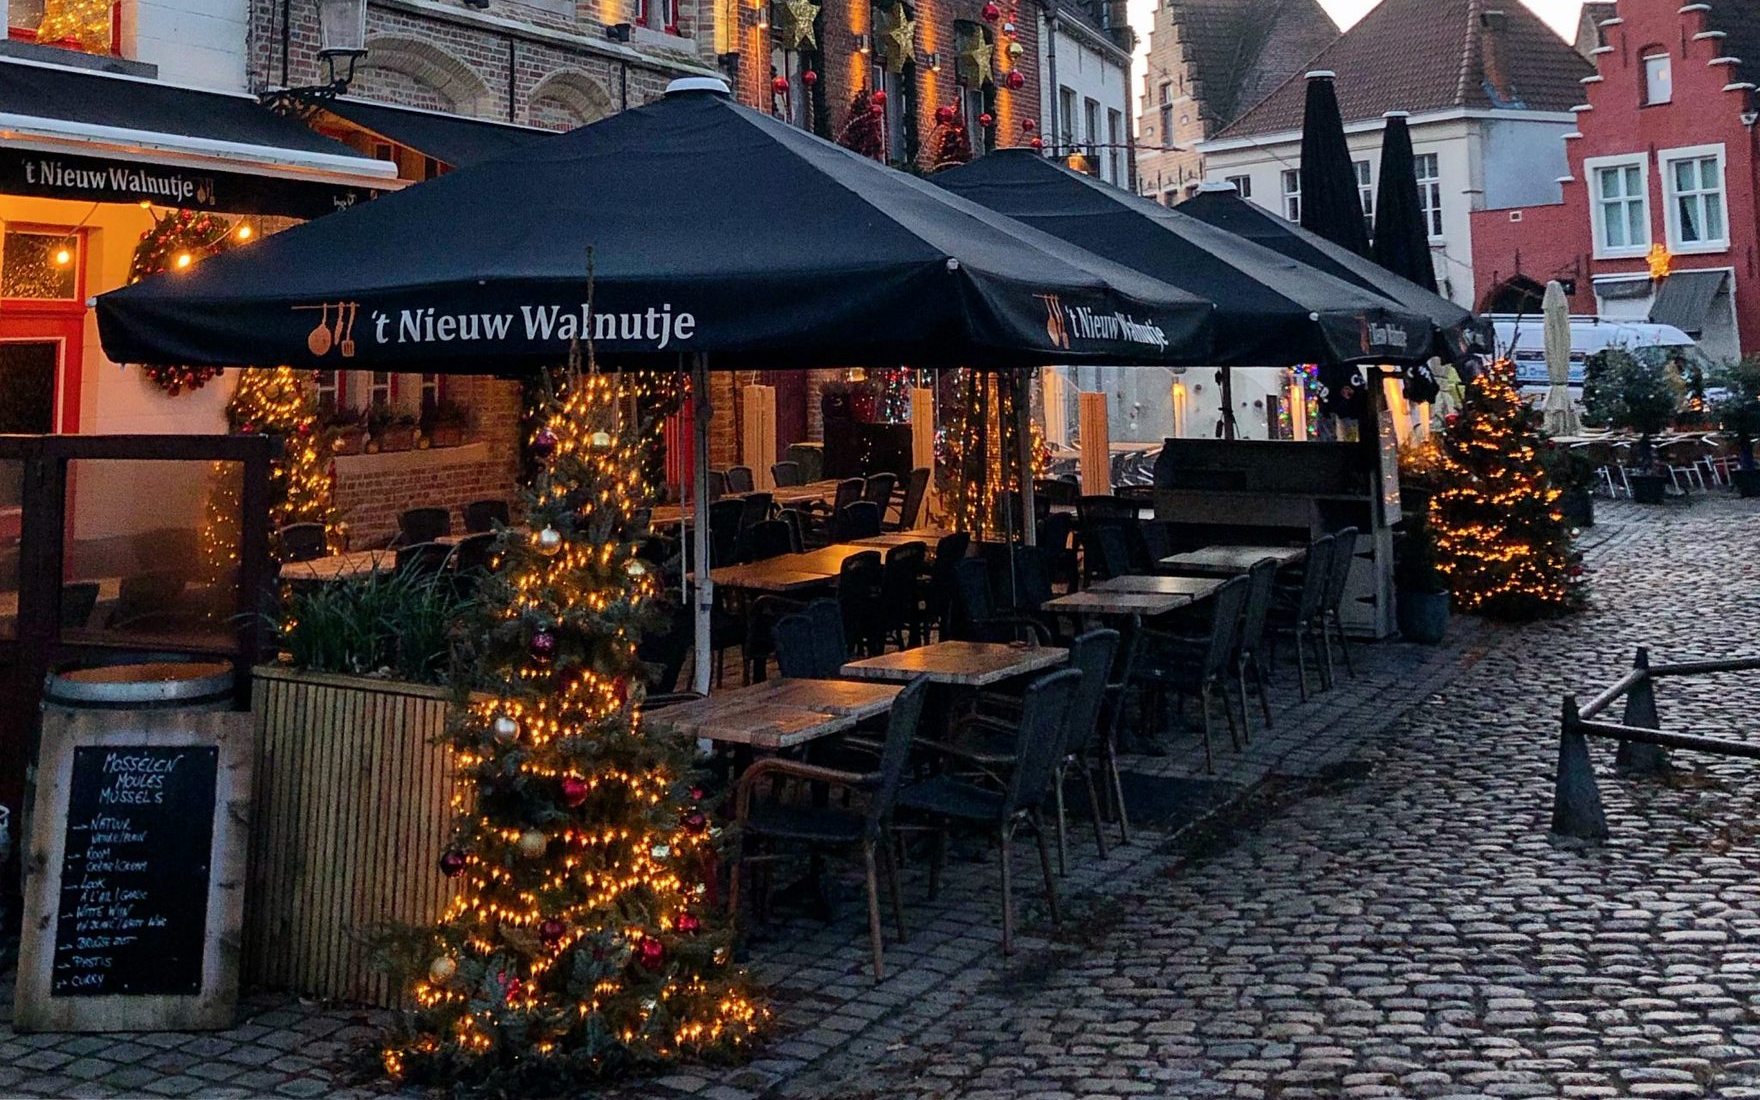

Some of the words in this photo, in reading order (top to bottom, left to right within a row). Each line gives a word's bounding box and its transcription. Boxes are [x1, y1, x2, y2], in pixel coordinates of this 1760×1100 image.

[39, 160, 107, 190] Nieuw
[108, 166, 194, 202] Walnutje
[397, 307, 512, 343] Nieuw
[519, 303, 696, 349] Walnutje
[1075, 306, 1119, 340] Nieuw
[102, 752, 184, 773] MOSSELEN
[115, 771, 164, 789] MOULES
